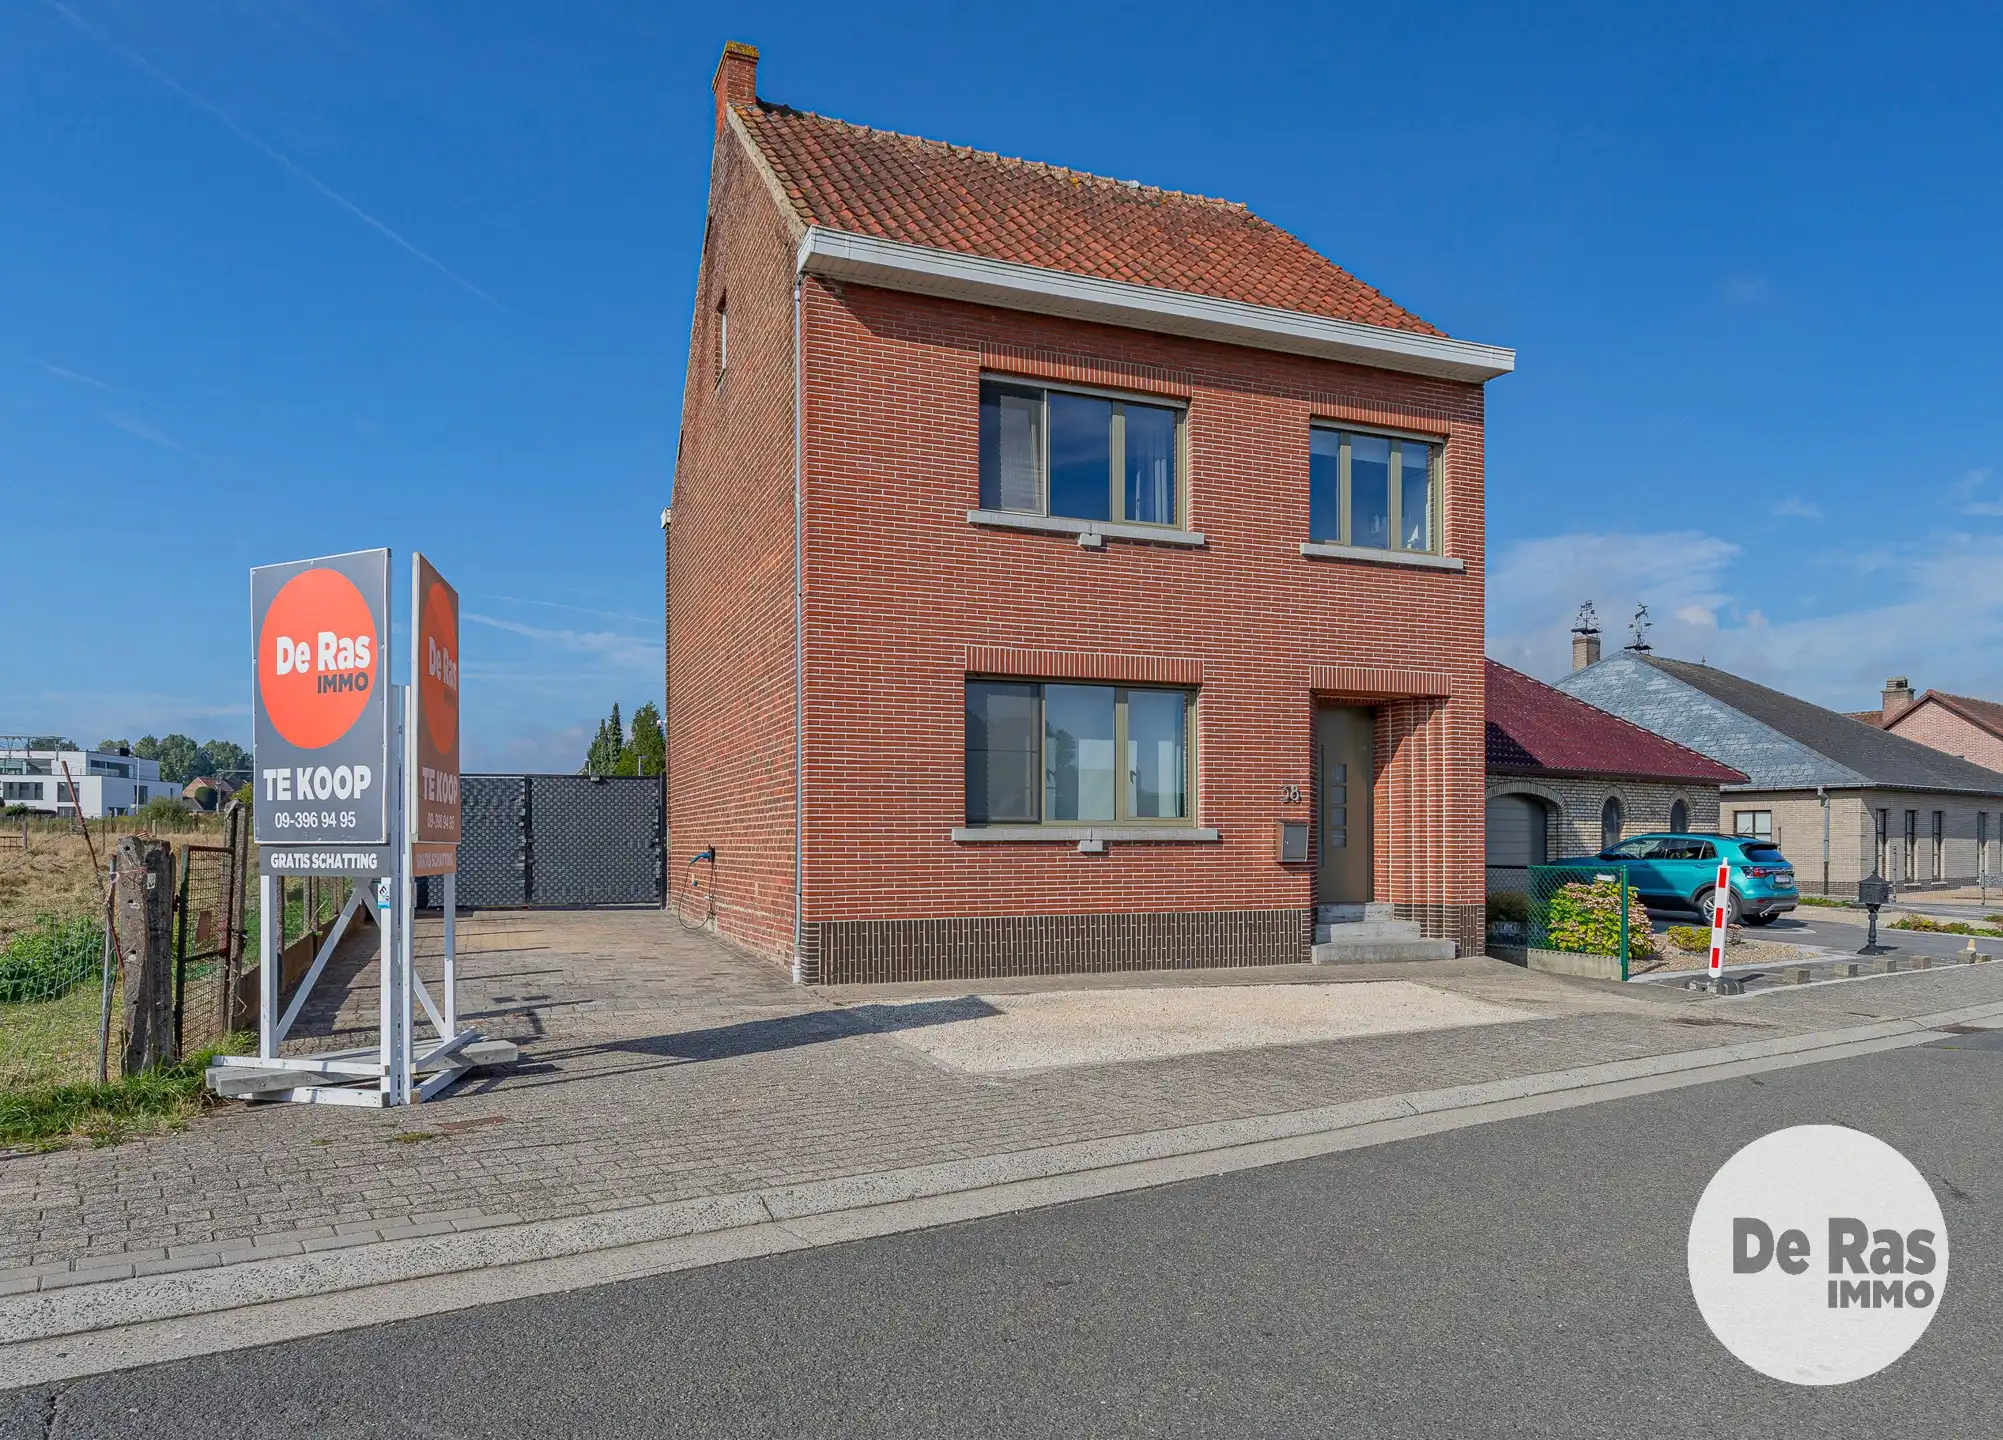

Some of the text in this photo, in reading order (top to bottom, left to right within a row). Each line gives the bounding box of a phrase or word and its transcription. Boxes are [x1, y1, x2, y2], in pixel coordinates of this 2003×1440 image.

[276, 631, 371, 675] De Ras
[428, 636, 457, 691] De Ras
[317, 671, 369, 694] IMMO
[262, 765, 372, 801] TE KOOP
[422, 766, 458, 805] TE KOOP
[274, 811, 356, 829] 09-396 94 95
[270, 853, 378, 870] GRATIS SCHATTING
